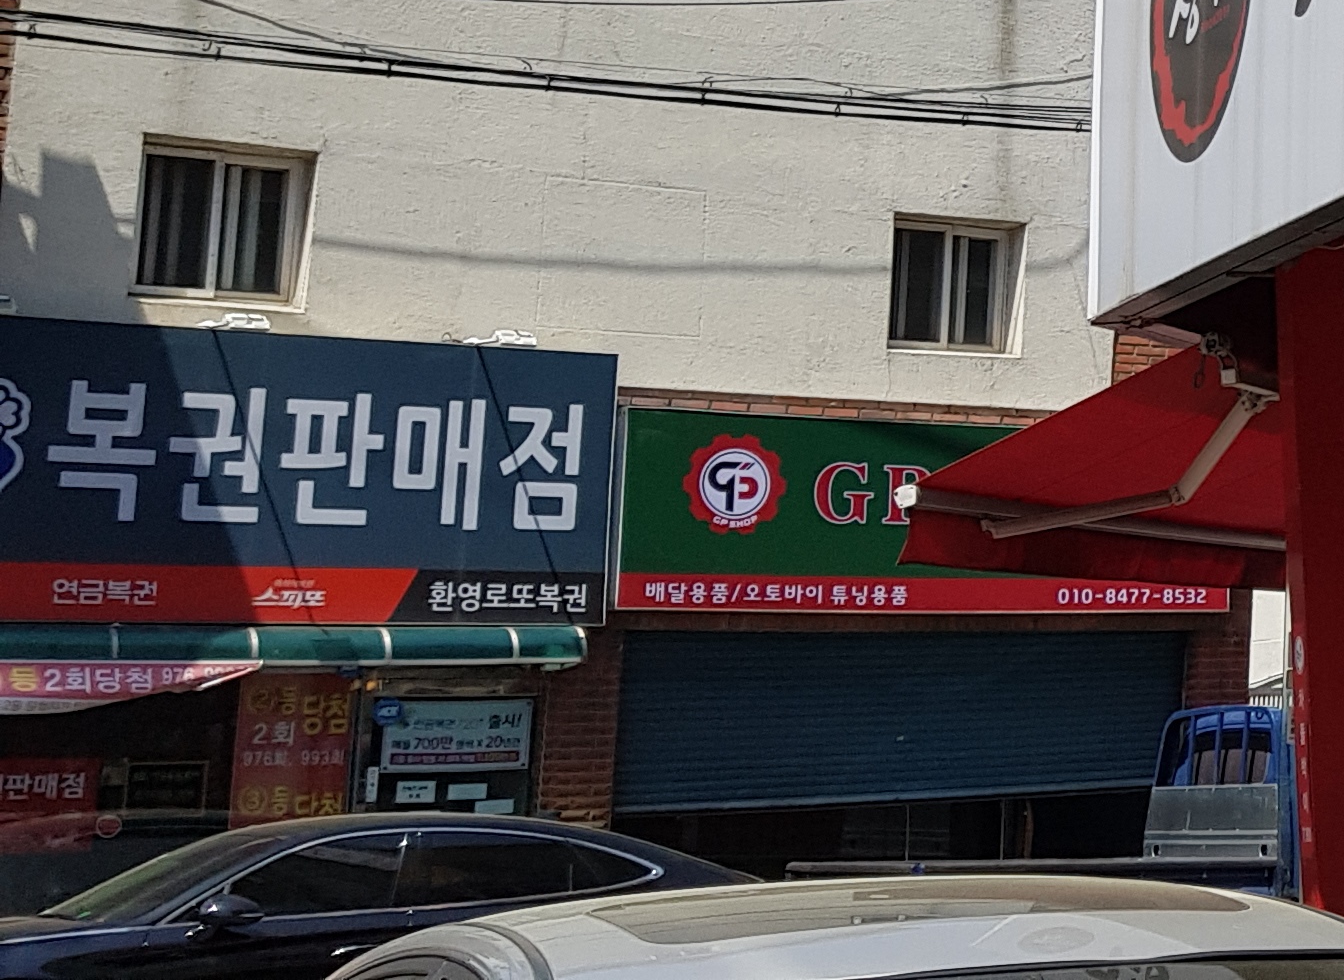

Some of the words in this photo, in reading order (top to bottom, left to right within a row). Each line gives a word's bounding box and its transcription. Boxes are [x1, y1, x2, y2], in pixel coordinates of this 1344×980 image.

[46, 380, 585, 531] 복권판매점
[52, 578, 158, 607] 연금복권
[251, 585, 327, 610] 스피또
[428, 581, 588, 614] 환영로또복권
[645, 581, 822, 606] 배달용품/오토바이
[830, 584, 909, 607] 튜닝용품
[1057, 587, 1207, 606] 010-8477-8532
[0, 772, 86, 802] 판매점
